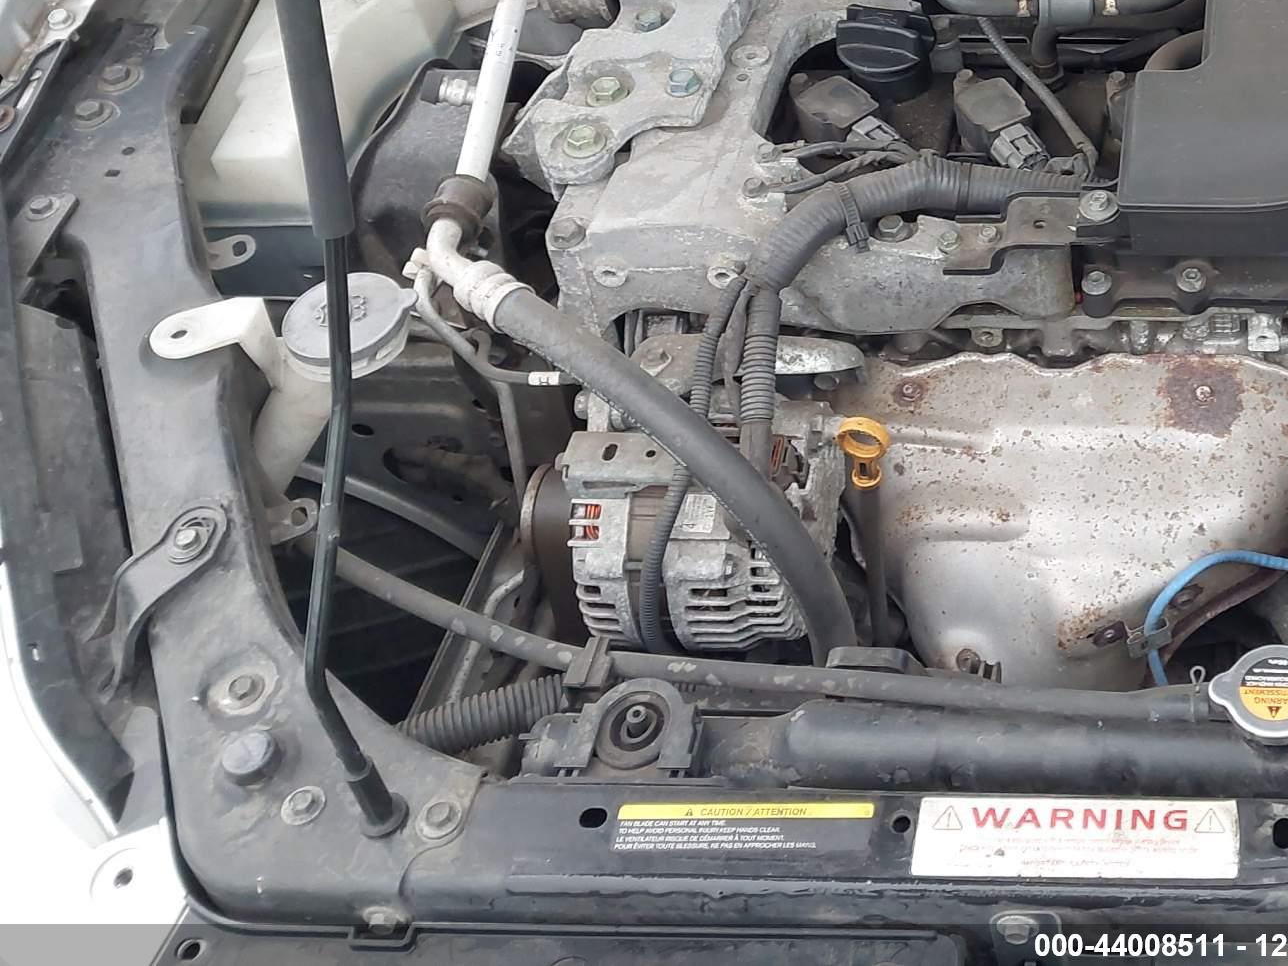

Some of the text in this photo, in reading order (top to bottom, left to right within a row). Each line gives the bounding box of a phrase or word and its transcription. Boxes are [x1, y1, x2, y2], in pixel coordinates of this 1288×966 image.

[700, 808, 744, 816] CAUTION
[754, 808, 807, 816] ATTENTION
[971, 806, 1190, 832] WARNING
